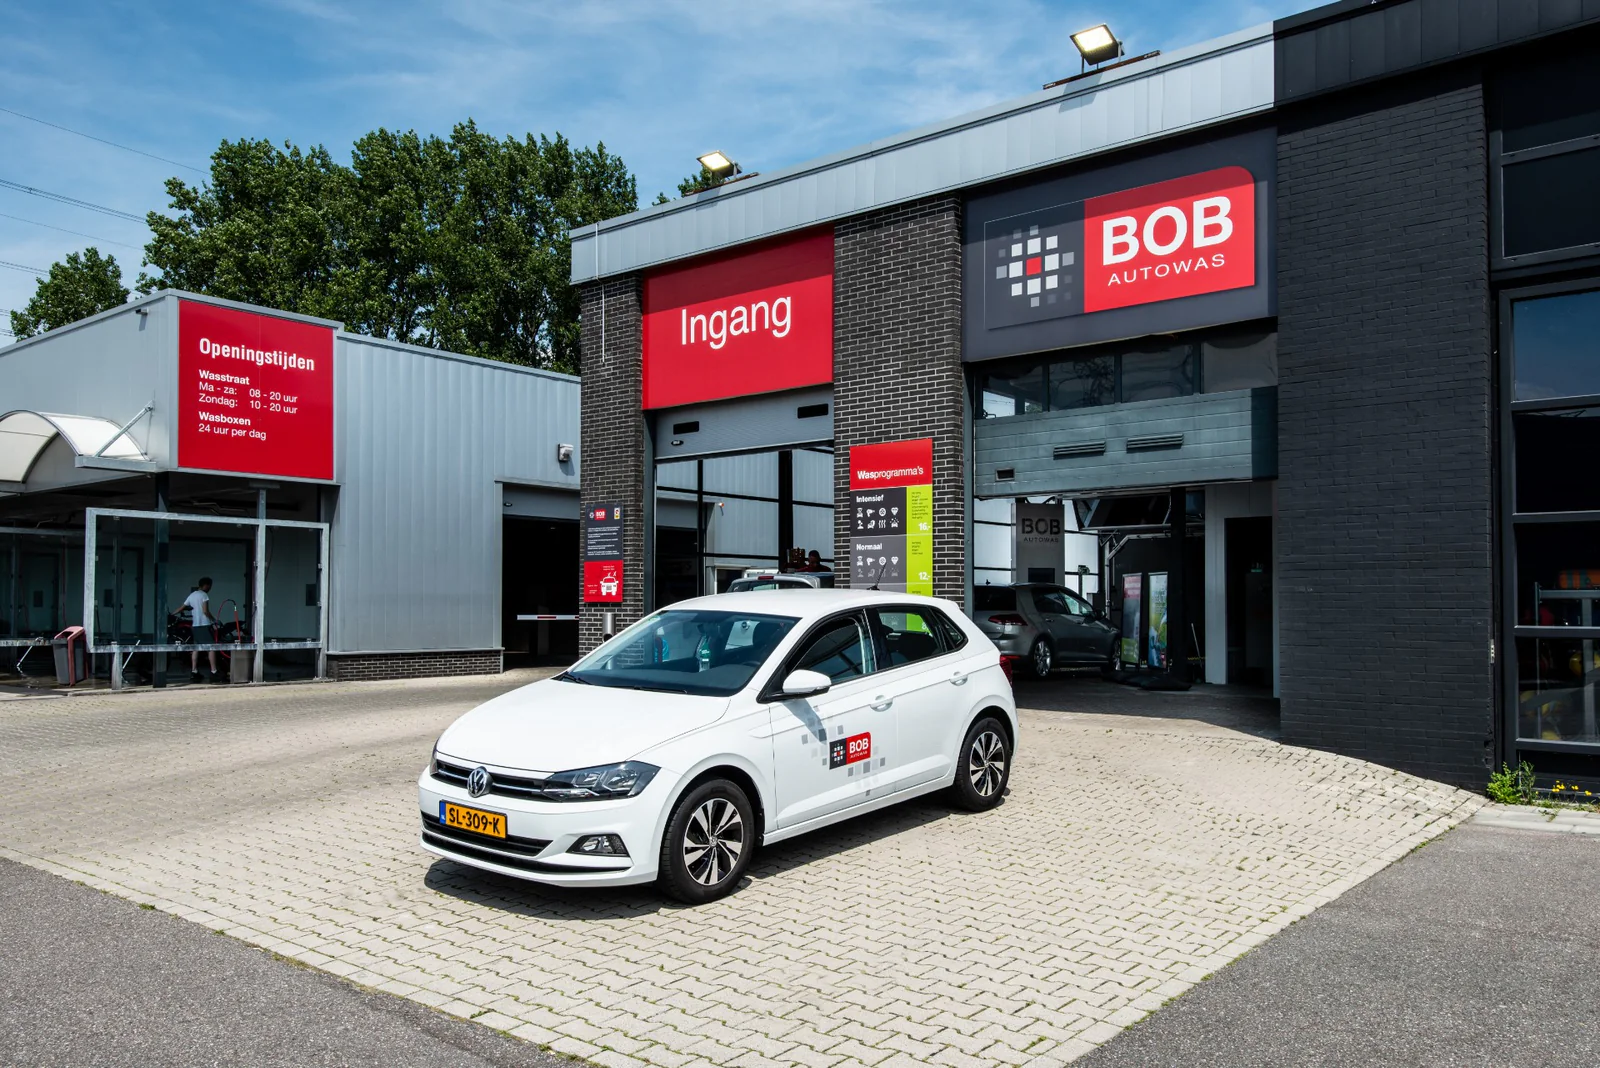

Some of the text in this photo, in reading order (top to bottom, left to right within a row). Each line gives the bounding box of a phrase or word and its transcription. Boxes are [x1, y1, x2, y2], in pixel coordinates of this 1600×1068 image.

[1102, 196, 1234, 266] BOB
[1108, 254, 1226, 287] AUTOWAS
[681, 296, 792, 350] Ingang
[199, 337, 315, 371] Openingstijden
[198, 369, 250, 385] Wasstraat
[199, 381, 214, 392] Ma
[223, 386, 237, 395] za:
[249, 388, 261, 398] 08
[269, 391, 281, 401] 20
[283, 394, 298, 403] uur
[198, 393, 238, 408] Zondag:
[249, 400, 261, 410] 10
[269, 402, 281, 412] 20
[283, 406, 298, 414] uur
[198, 411, 251, 426] Wasboxen
[198, 423, 267, 441] 24 uur per dag
[857, 466, 924, 480] Wasprogramma's
[856, 494, 884, 503] Intensief
[1021, 518, 1061, 535] BOB
[856, 543, 883, 551] Normaal
[849, 738, 869, 754] BOB
[448, 807, 501, 834] SL-309-K
